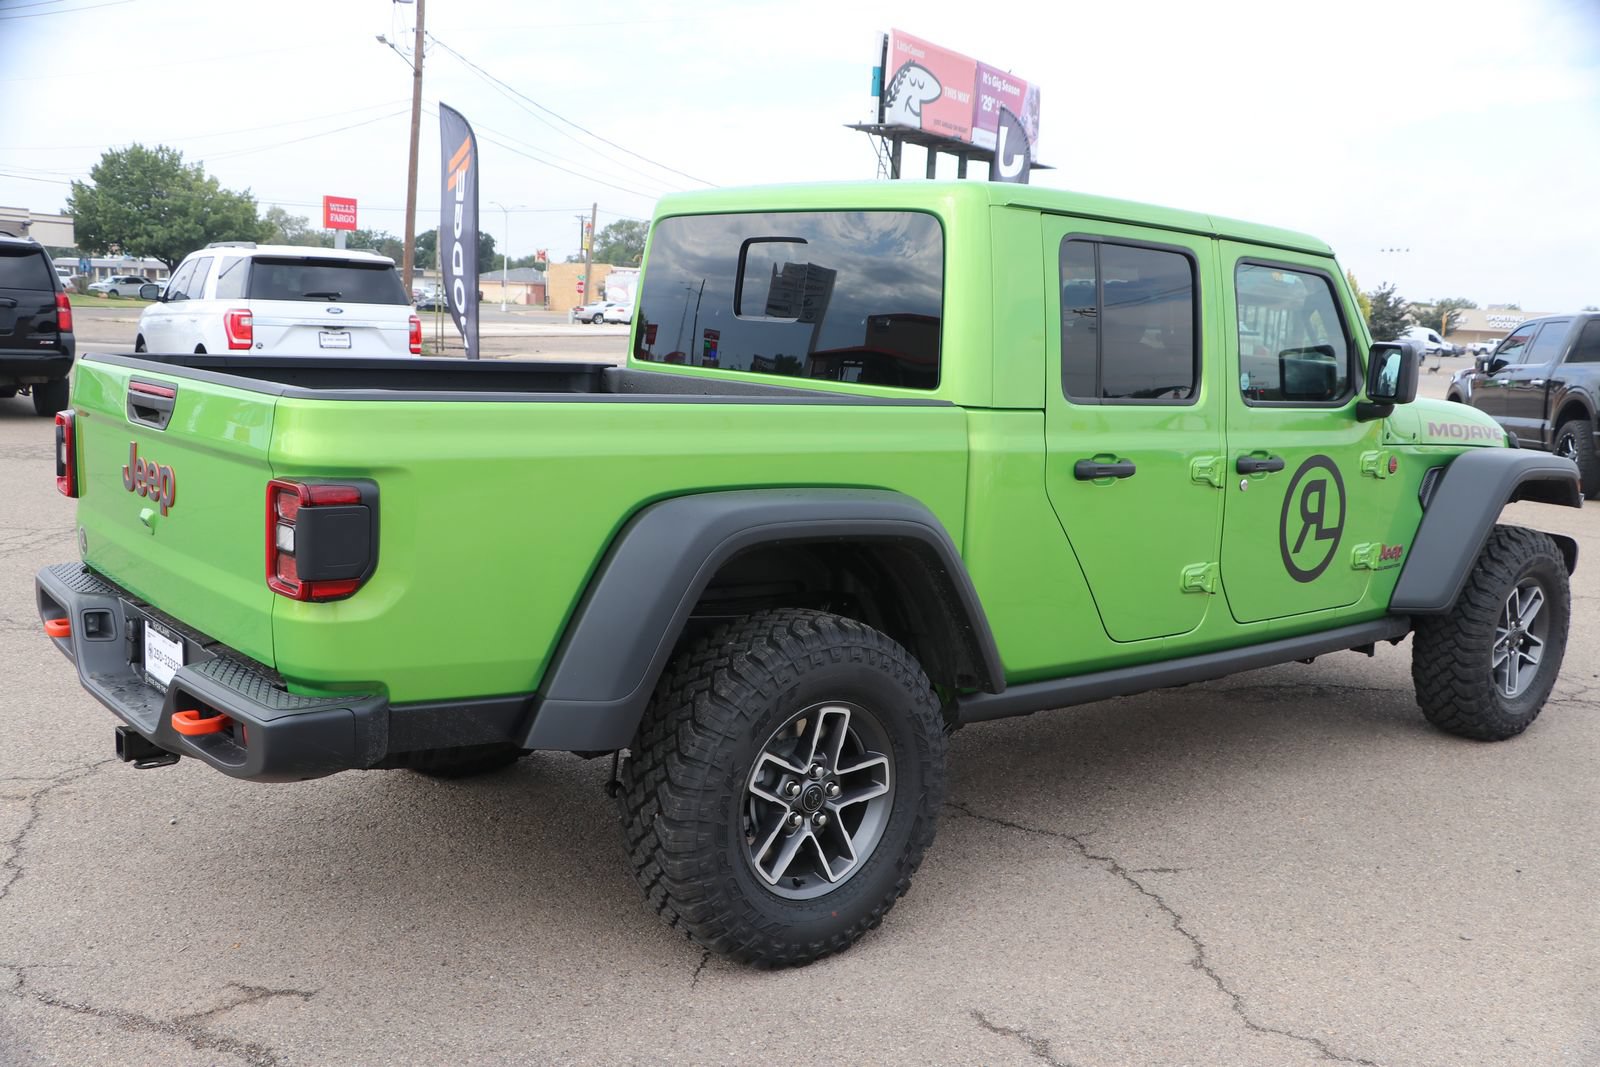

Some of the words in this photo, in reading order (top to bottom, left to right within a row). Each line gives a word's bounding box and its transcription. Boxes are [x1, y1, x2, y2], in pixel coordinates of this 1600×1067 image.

[992, 75, 1001, 91] Gig
[1002, 80, 1020, 96] Season
[329, 203, 355, 213] WELLS
[330, 213, 355, 224] FARGO
[1427, 422, 1503, 441] MOJAVE
[122, 441, 176, 517] Jeep
